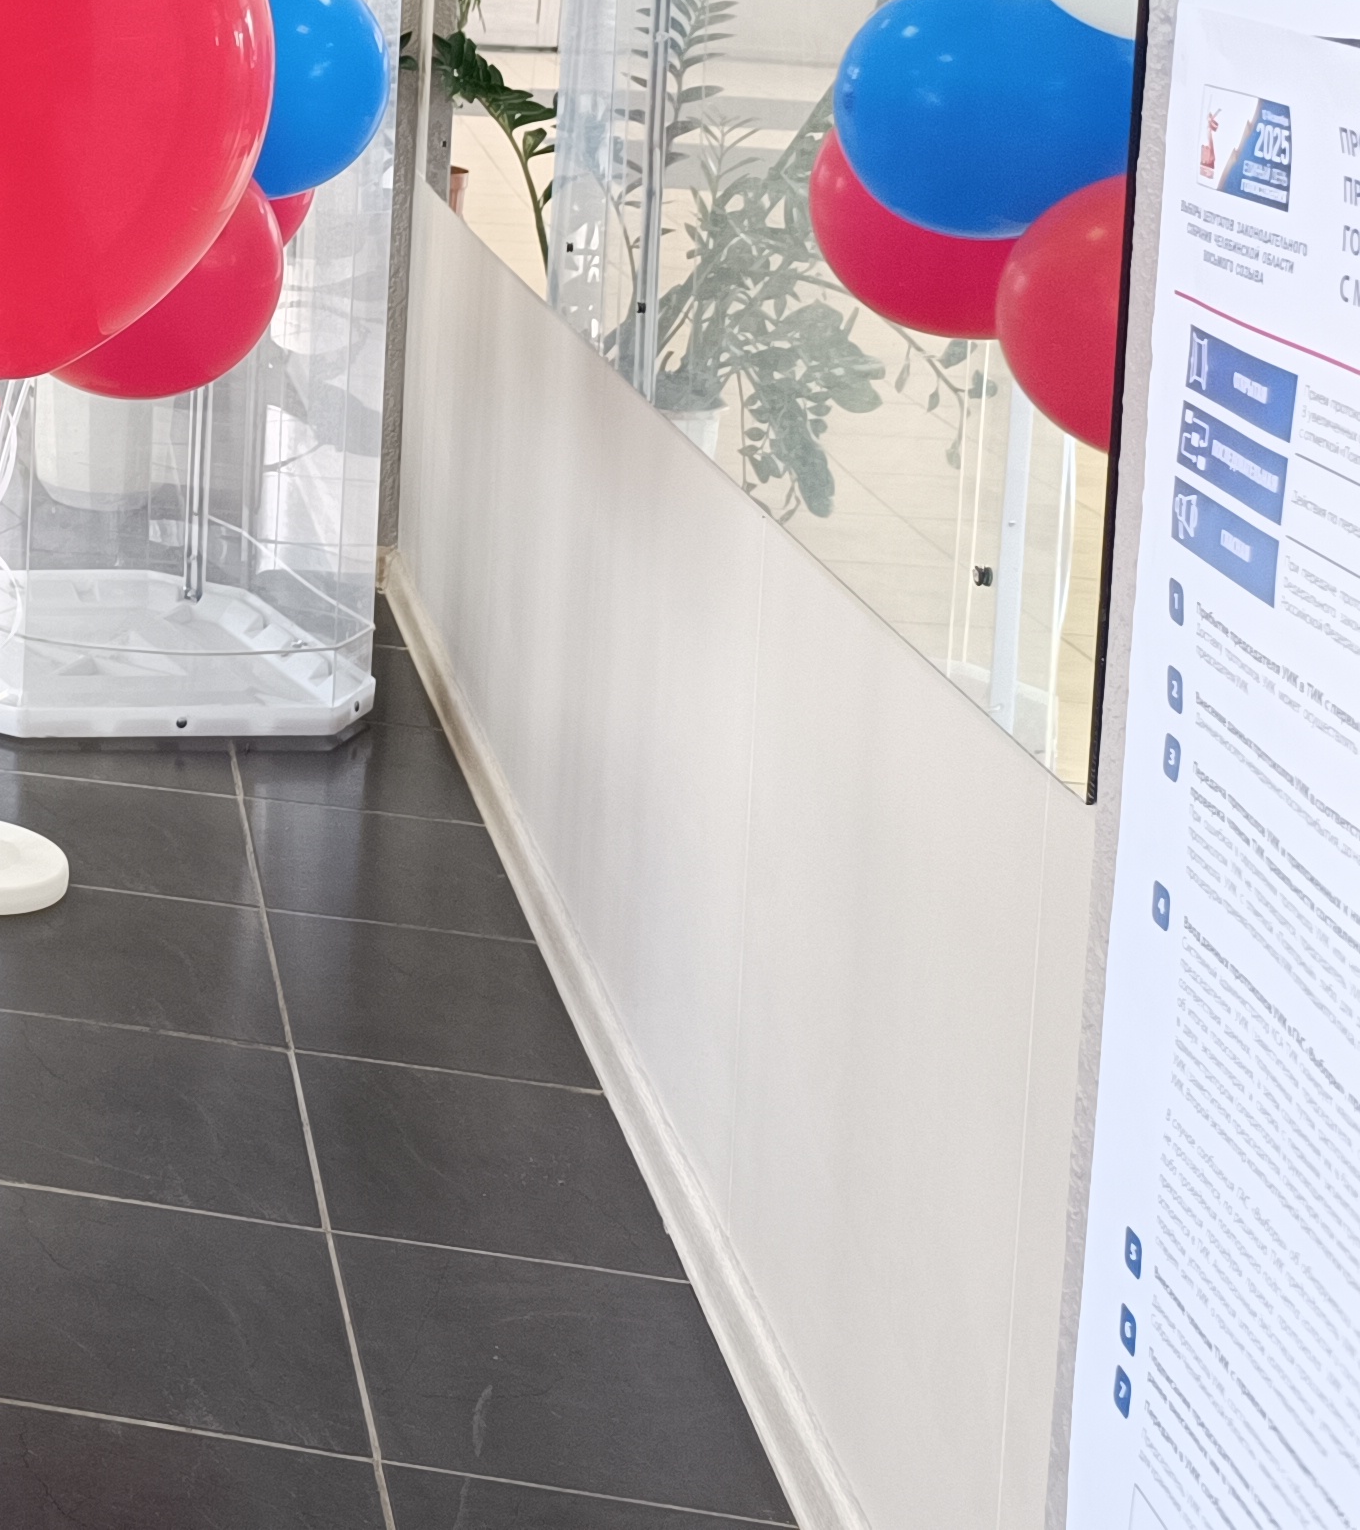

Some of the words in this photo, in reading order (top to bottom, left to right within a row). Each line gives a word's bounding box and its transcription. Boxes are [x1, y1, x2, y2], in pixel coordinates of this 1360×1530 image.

[1254, 122, 1290, 165] 2025
[1339, 126, 1360, 157] ПР
[1262, 252, 1294, 274] ОБЛАСТИ
[1173, 592, 1179, 610] 1
[1172, 681, 1178, 698] 2
[1168, 748, 1176, 766] 3
[1129, 1242, 1137, 1261] 5
[1124, 1320, 1132, 1339] 6
[1118, 1381, 1126, 1399] 7
